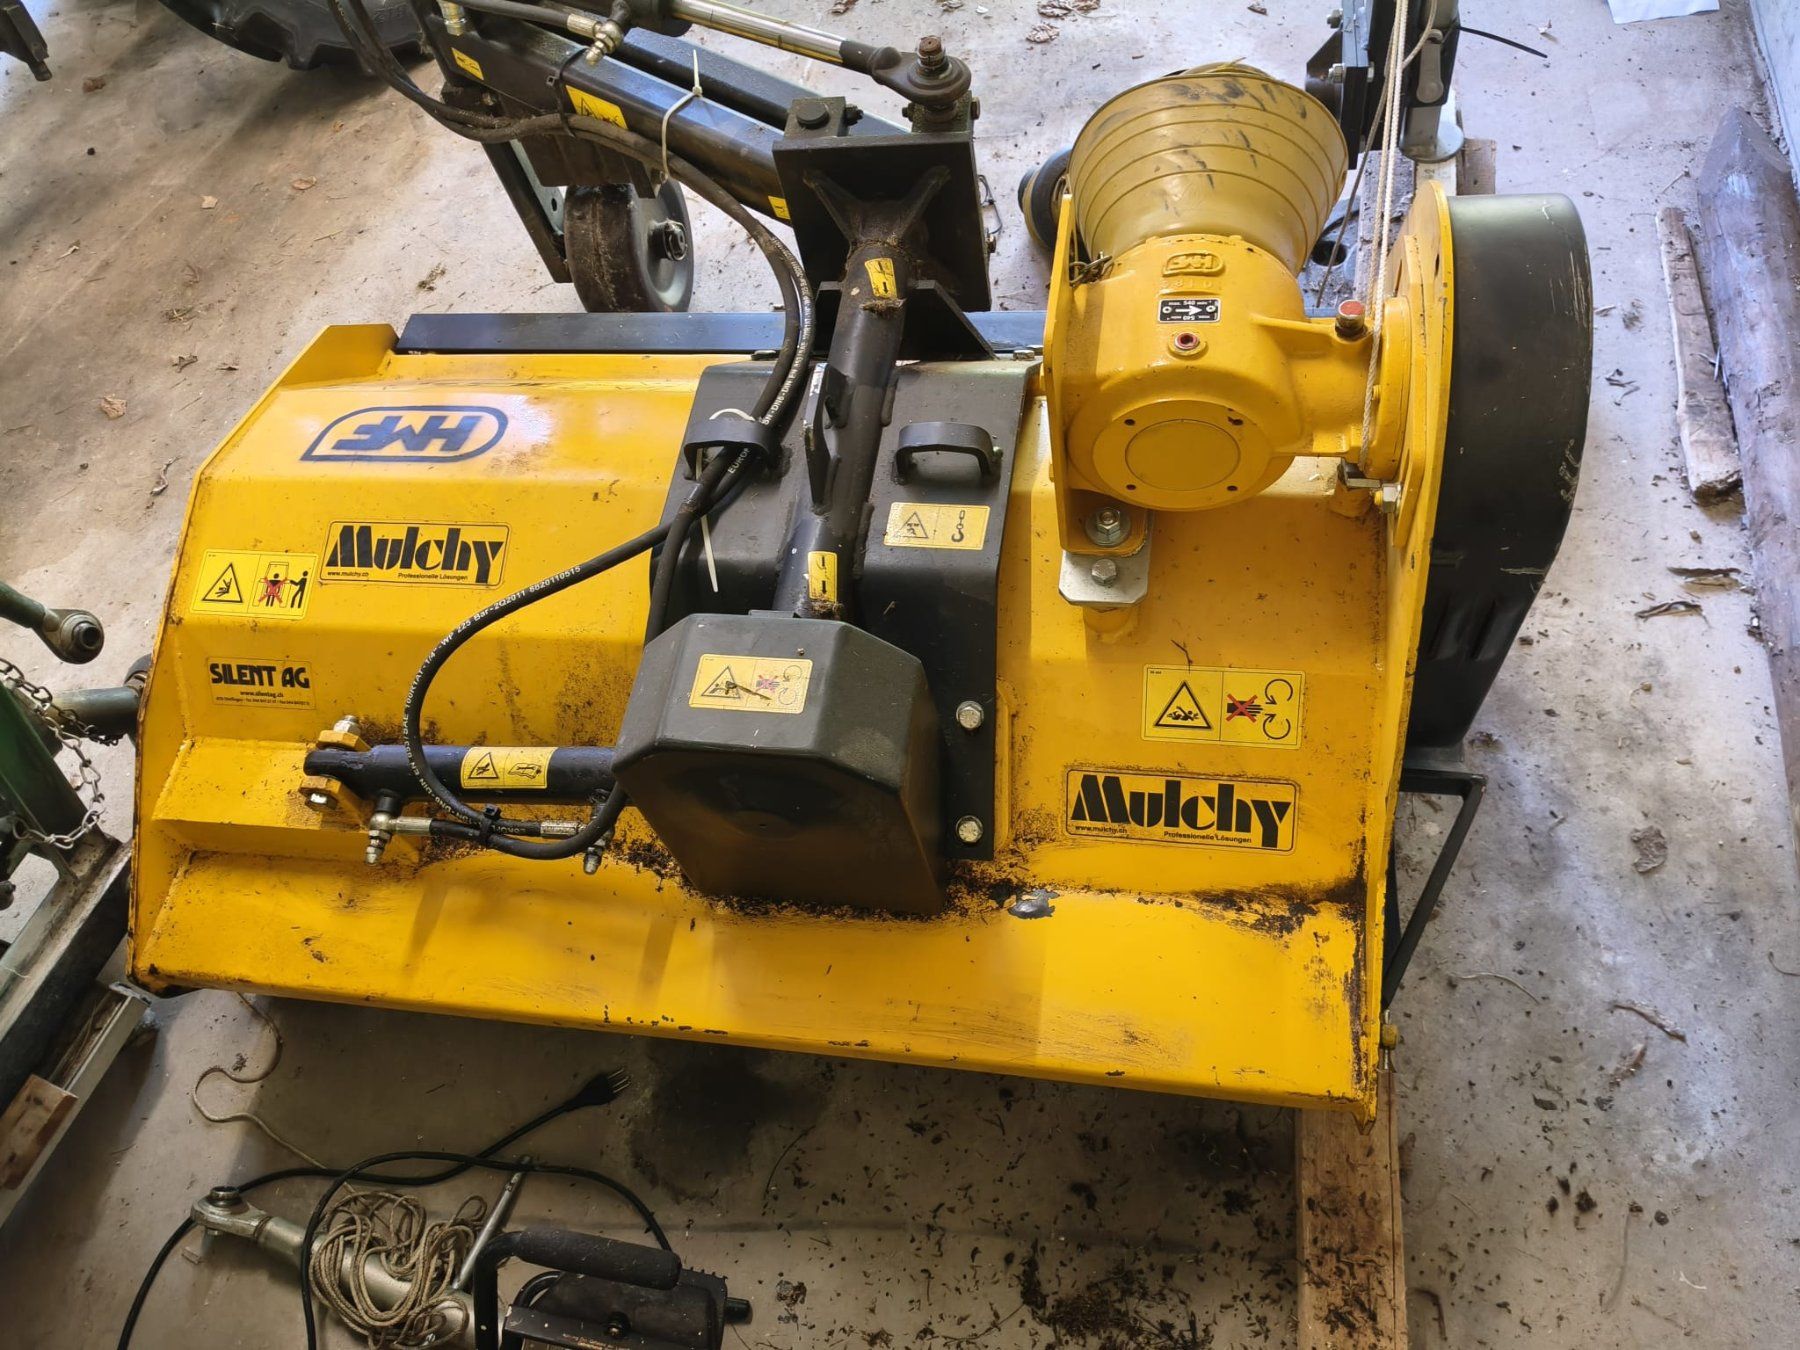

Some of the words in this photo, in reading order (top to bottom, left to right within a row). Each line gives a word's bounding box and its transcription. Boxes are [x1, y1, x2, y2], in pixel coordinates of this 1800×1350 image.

[331, 415, 485, 452] HMF
[325, 525, 504, 584] Mulchy
[457, 620, 472, 634] 225
[209, 663, 277, 687] SILENT
[281, 667, 310, 689] AG
[1070, 774, 1292, 848] Mulchy
[1163, 830, 1215, 841] Professionelle
[1216, 832, 1252, 844] Lösungen
